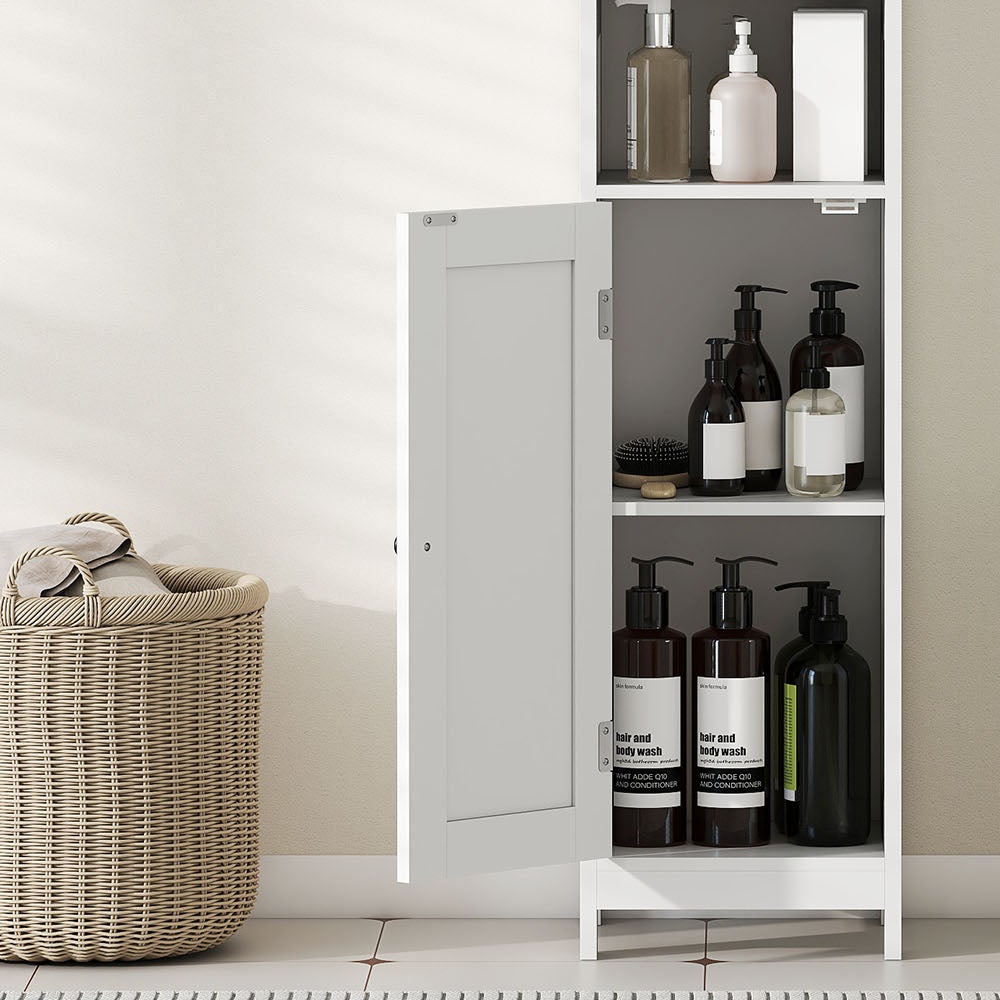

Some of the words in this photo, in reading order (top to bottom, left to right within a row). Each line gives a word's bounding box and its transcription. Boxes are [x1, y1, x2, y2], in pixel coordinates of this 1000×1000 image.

[616, 732, 632, 743] hair
[633, 733, 652, 743] and
[699, 732, 716, 743] hair
[717, 733, 736, 743] and
[616, 746, 635, 757] body
[637, 746, 662, 757] wash
[699, 745, 720, 757] body
[721, 746, 747, 757] wash
[654, 773, 668, 781] Q10
[738, 773, 752, 781] Q10
[629, 781, 678, 789] CONDITIONER
[713, 781, 762, 789] CONDITIONER
